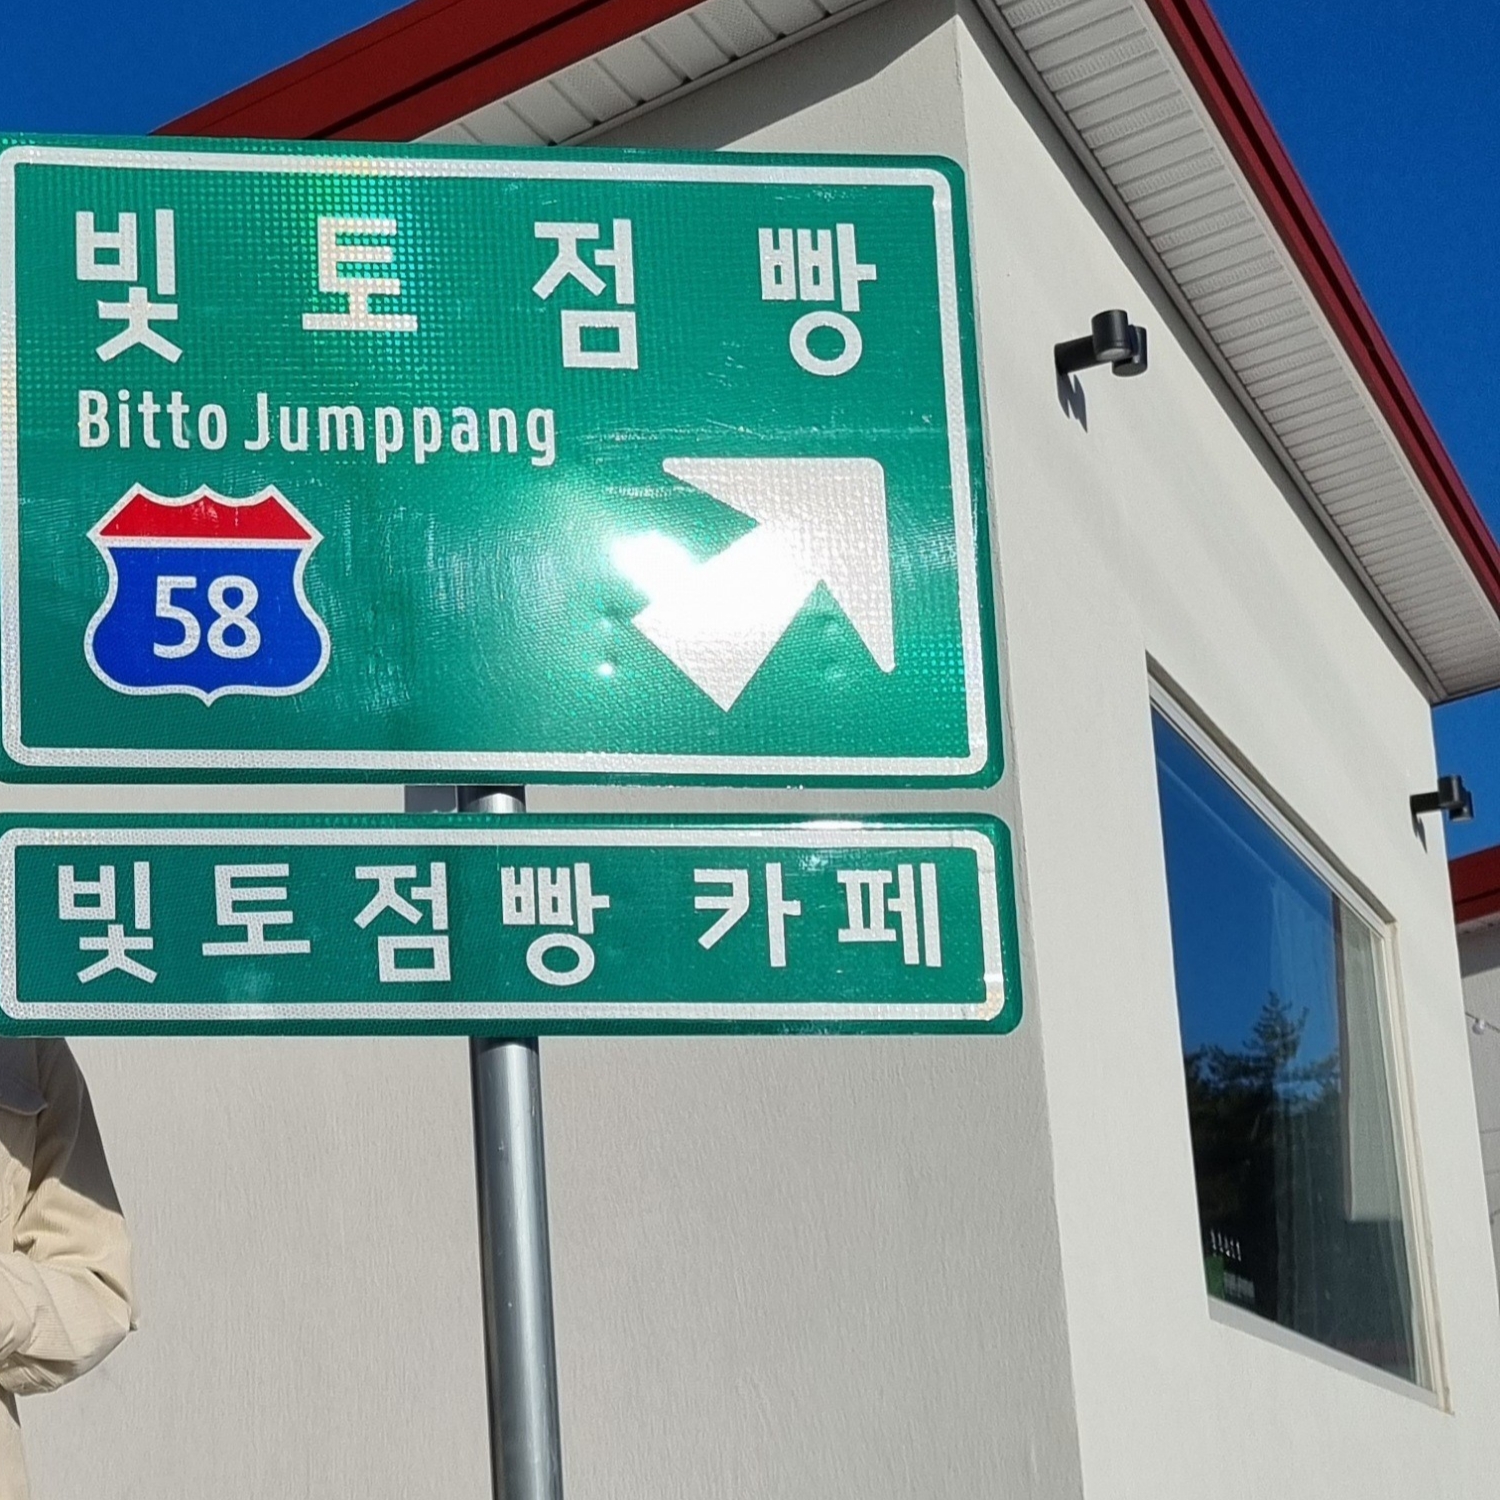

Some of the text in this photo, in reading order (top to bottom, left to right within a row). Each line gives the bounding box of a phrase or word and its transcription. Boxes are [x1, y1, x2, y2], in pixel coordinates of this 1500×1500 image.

[77, 389, 556, 467] Bitto Jumppang
[153, 575, 261, 659] 58
[58, 862, 942, 986] 빛토점빵 카페
